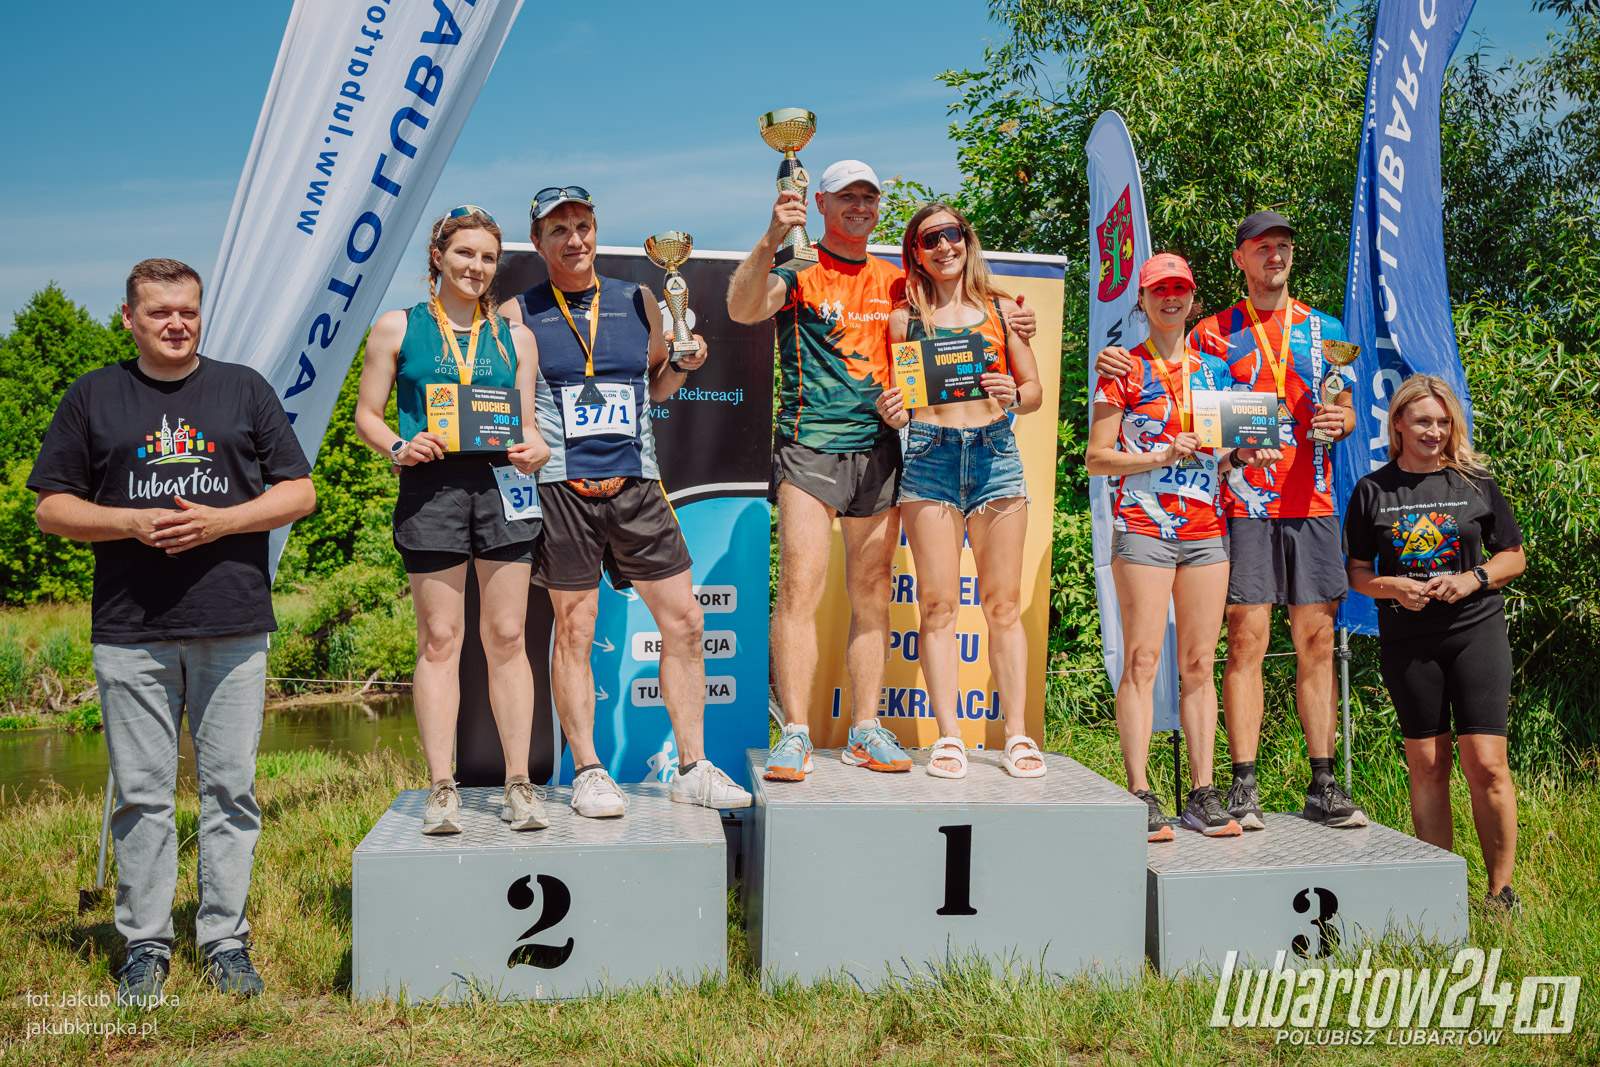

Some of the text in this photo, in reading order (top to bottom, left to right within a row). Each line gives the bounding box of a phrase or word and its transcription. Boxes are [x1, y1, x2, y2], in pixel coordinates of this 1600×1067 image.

[934, 351, 974, 367] VOUCHER
[957, 361, 983, 375] 500 zł
[679, 387, 744, 406] Rekreacji
[471, 400, 511, 414] VOUCHER
[574, 404, 630, 426] 37/1
[1231, 405, 1268, 416] VOUCHER
[493, 413, 519, 426] 300 zł
[1251, 415, 1276, 426] 200 zł
[1159, 465, 1211, 493] 26/2
[510, 486, 538, 509] 37
[937, 825, 978, 917] 1
[507, 874, 576, 970] 2
[1292, 887, 1339, 960] 3
